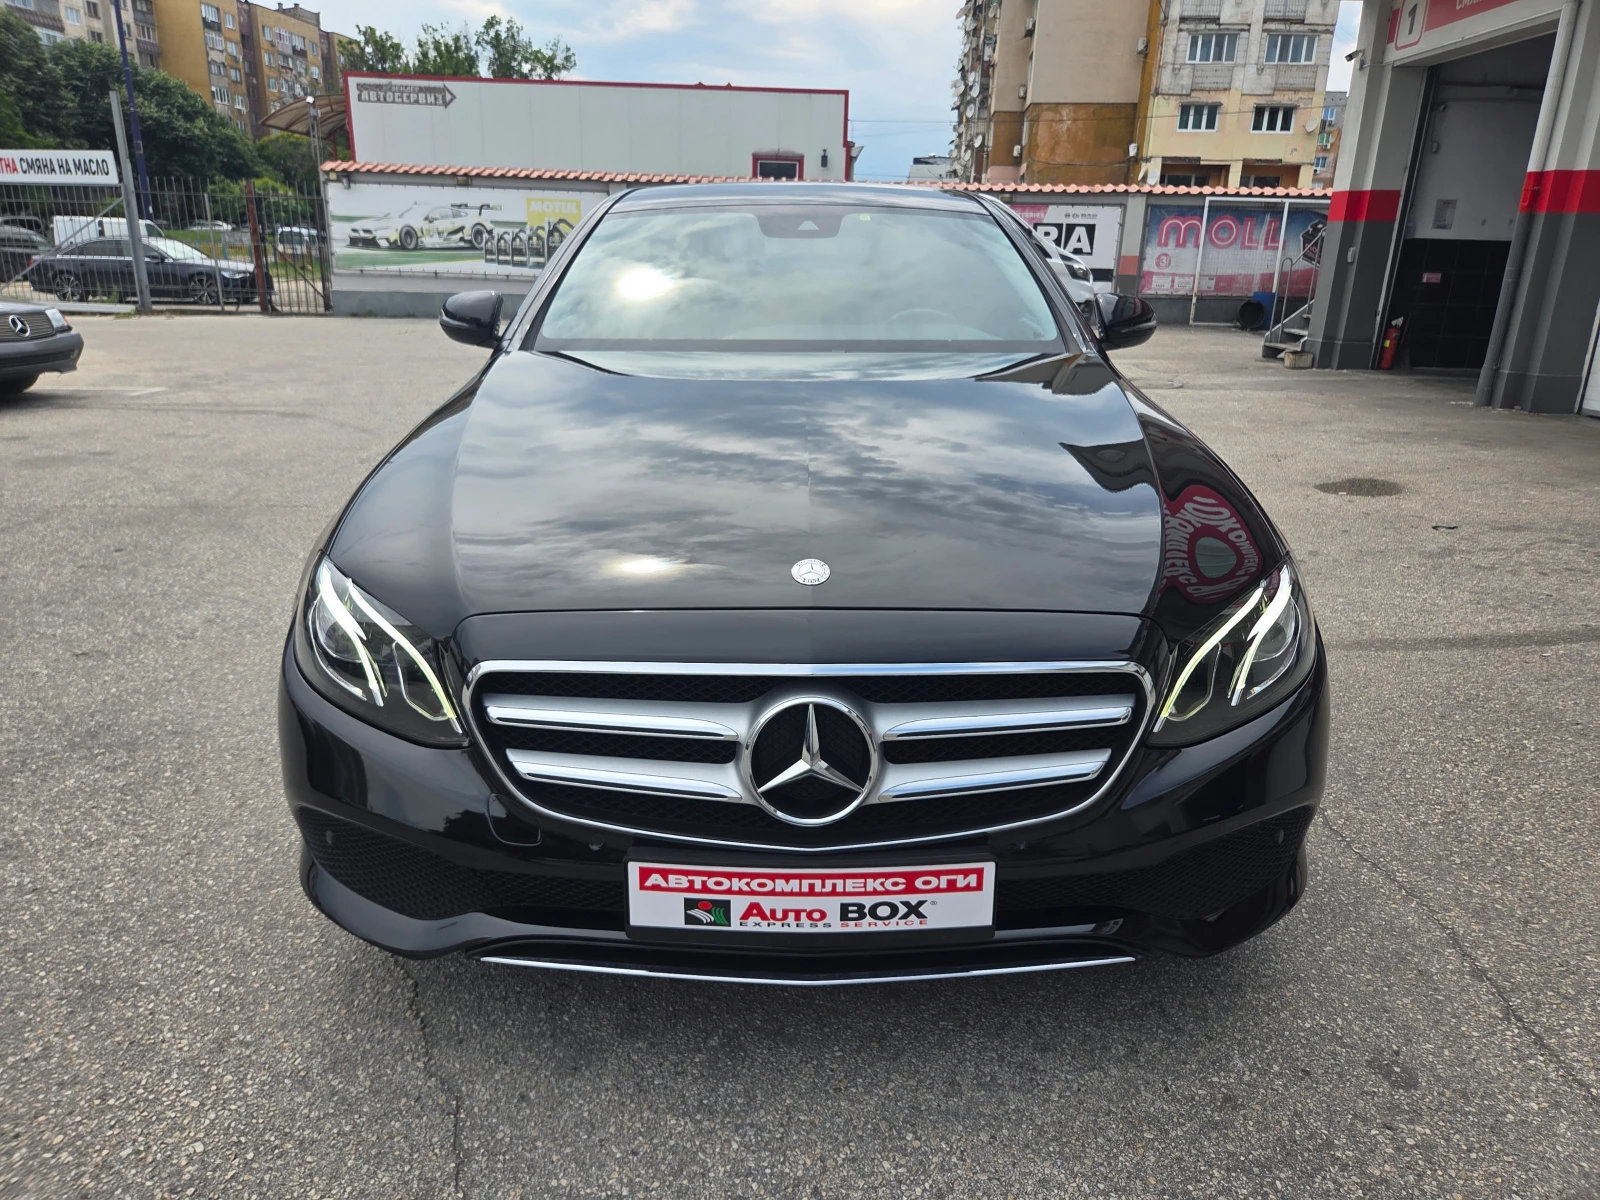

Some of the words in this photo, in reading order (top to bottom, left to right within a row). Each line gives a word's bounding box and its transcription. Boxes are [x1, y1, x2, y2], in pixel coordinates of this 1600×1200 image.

[361, 90, 443, 104] АВТОСЕРВИЗ
[0, 157, 19, 174] ТНА
[19, 157, 57, 175] СМЯНА
[57, 158, 73, 176] НА
[73, 158, 110, 176] МАСЛО
[530, 201, 578, 214] MOTUL
[644, 873, 907, 893] АВТОКОМПЛЕКС
[914, 873, 978, 889] ОГИ
[840, 919, 928, 928] SERVICE
